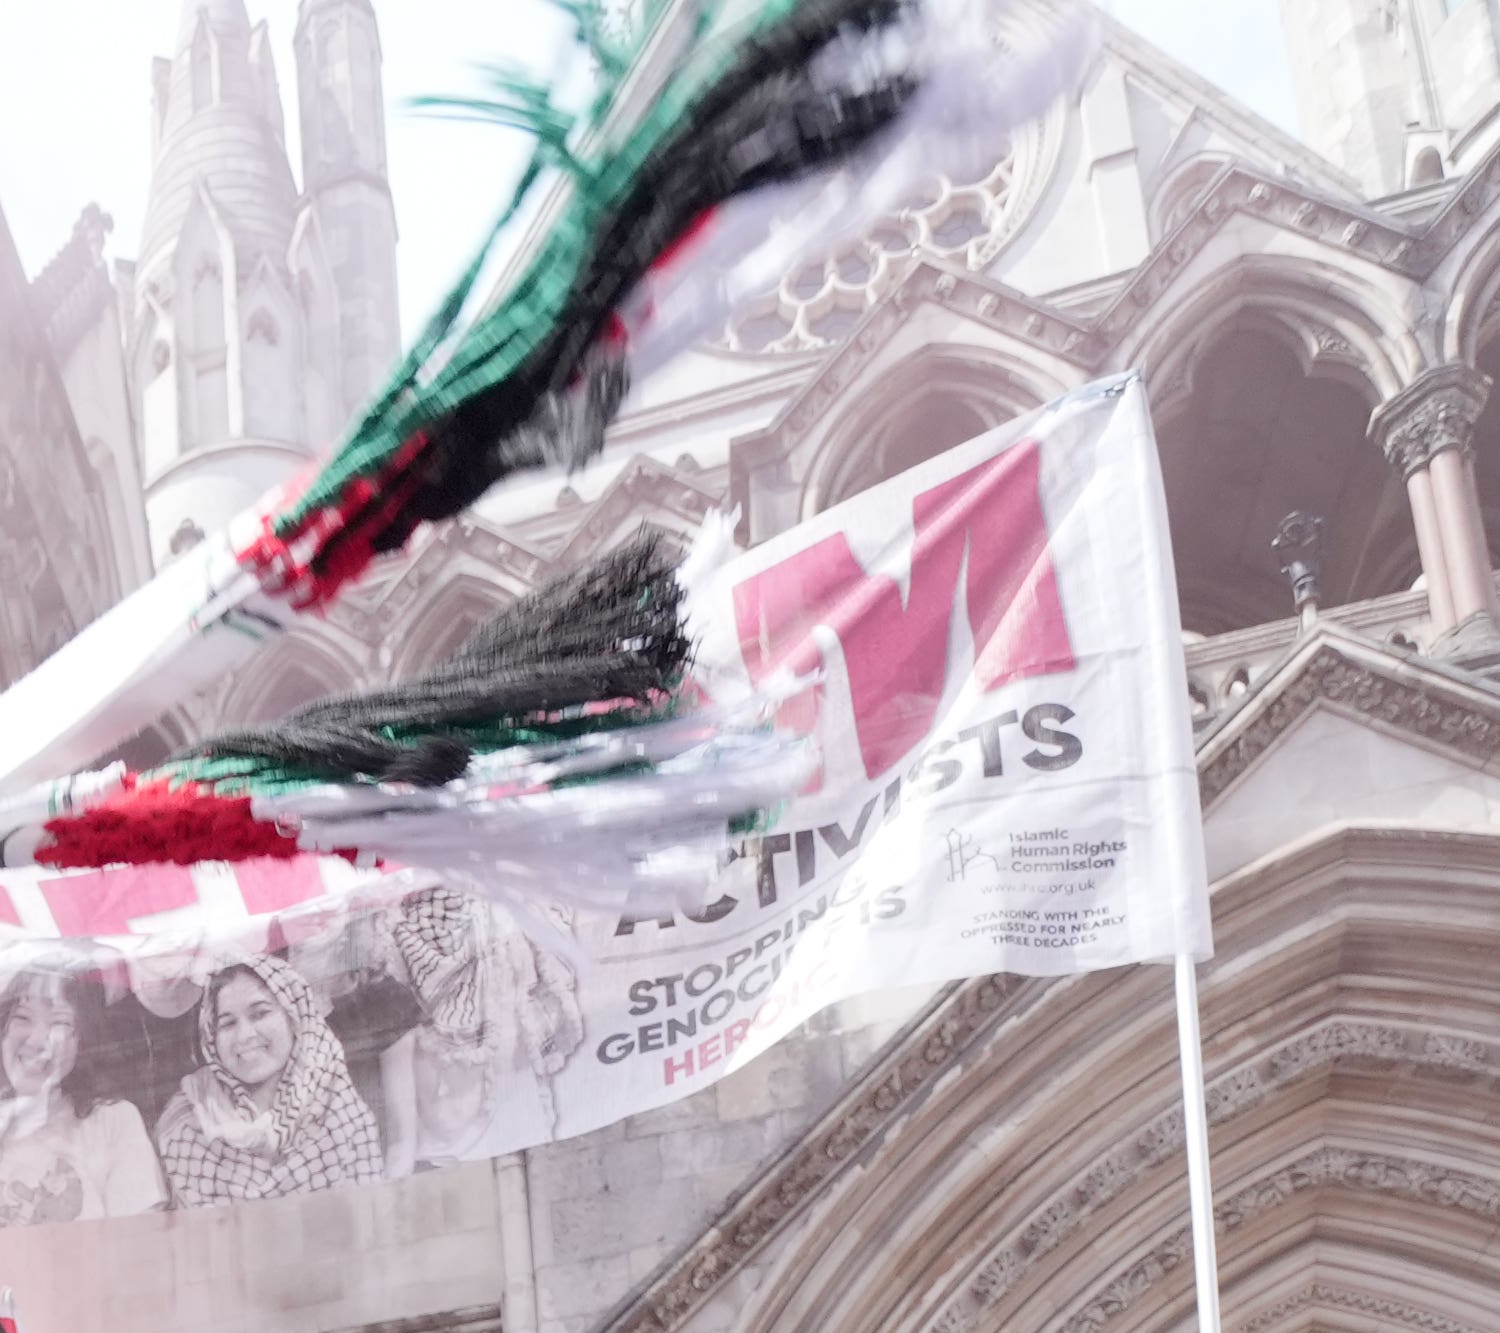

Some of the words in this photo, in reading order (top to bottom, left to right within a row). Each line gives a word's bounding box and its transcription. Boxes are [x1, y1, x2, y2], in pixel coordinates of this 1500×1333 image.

[1009, 828, 1069, 843] Islamic
[1010, 844, 1070, 859] Human
[1072, 840, 1128, 858] Rights
[1010, 858, 1116, 874] Commission
[973, 909, 1040, 925] STANDING
[1044, 910, 1078, 922] WITH
[1083, 906, 1110, 920] THE
[1040, 924, 1067, 935] FOR
[1070, 914, 1127, 933] NEARLY
[992, 935, 1030, 948] THREE
[1033, 933, 1098, 949] DECADES
